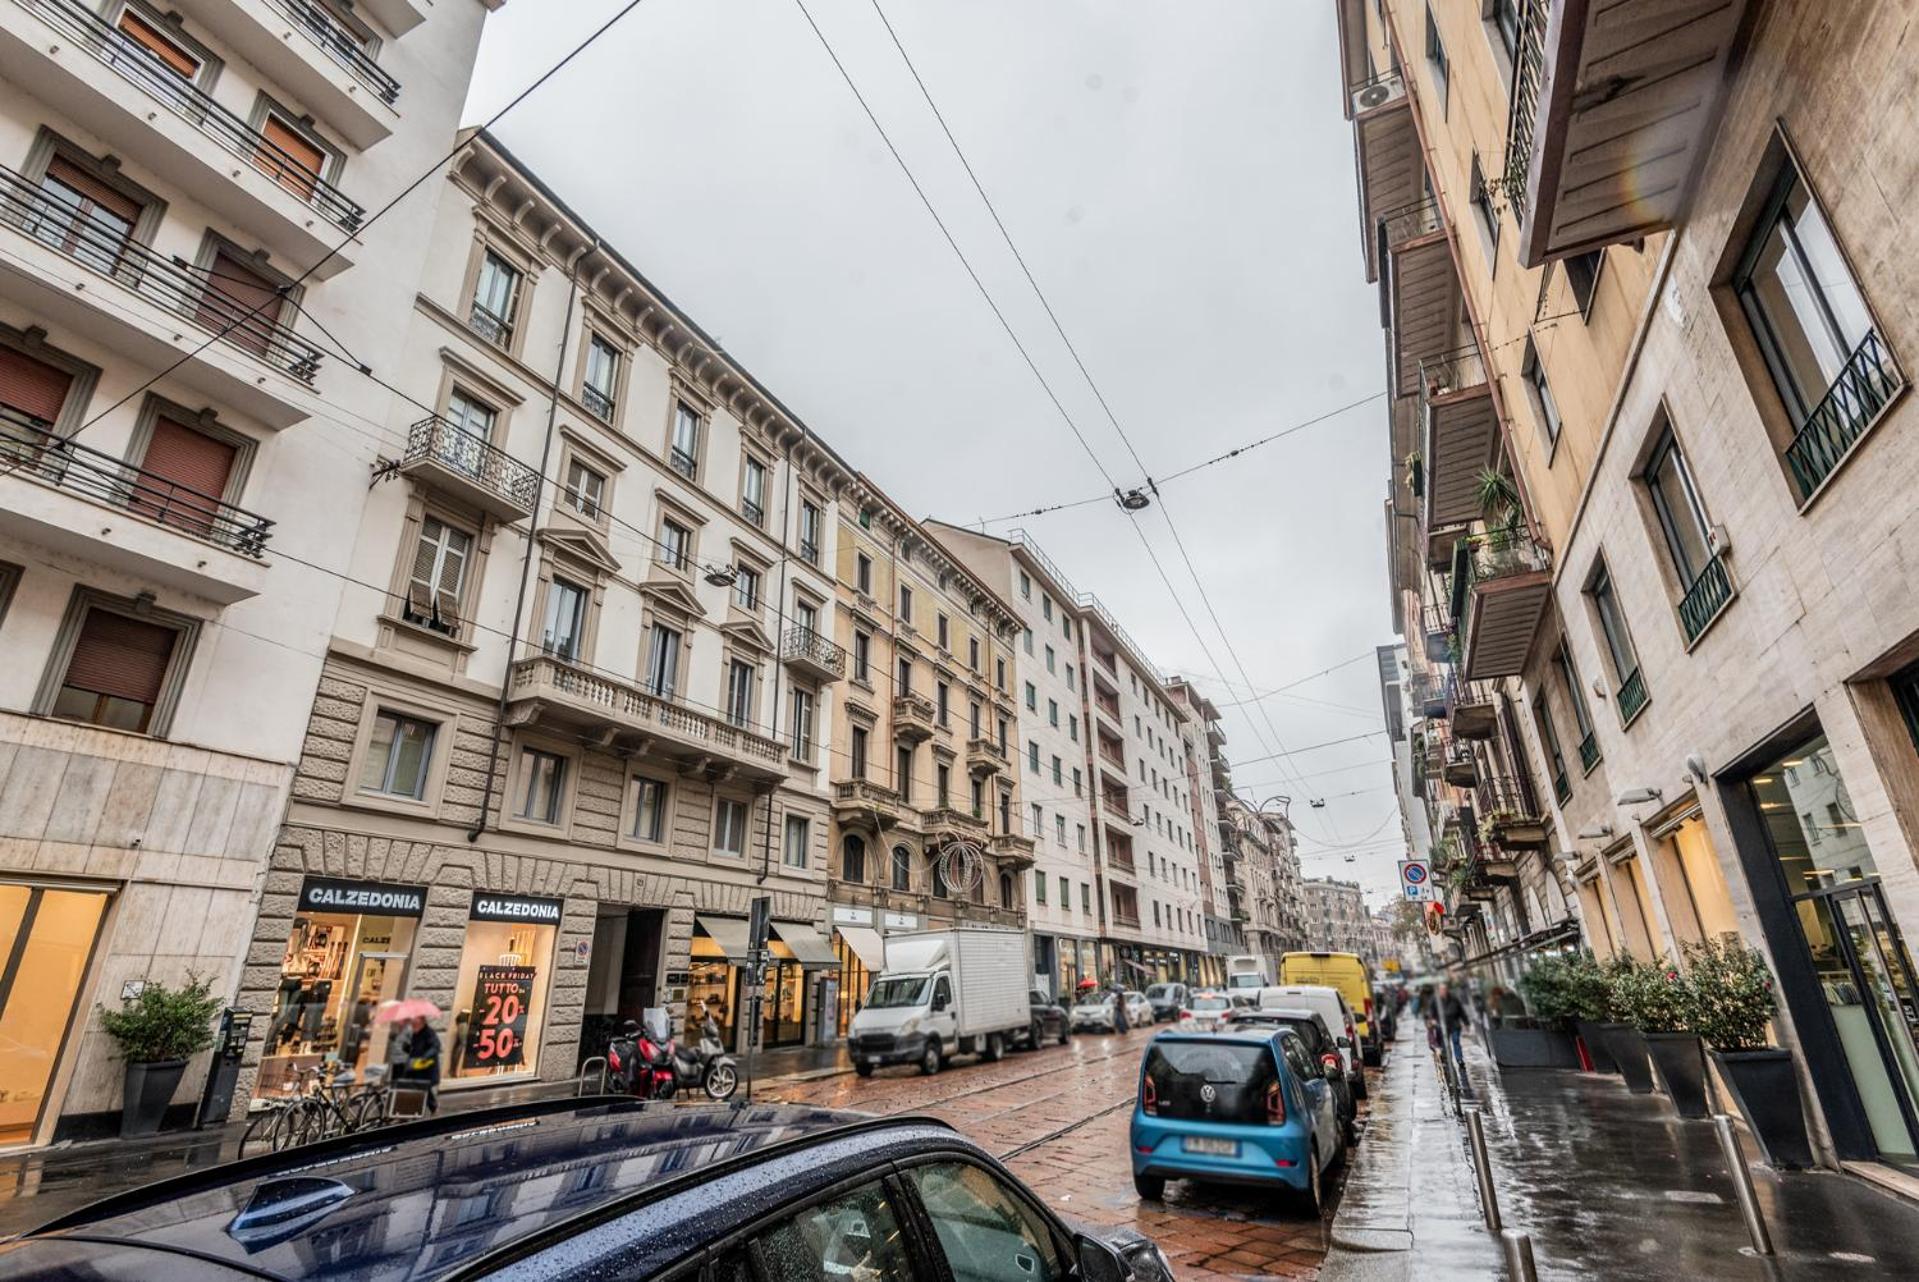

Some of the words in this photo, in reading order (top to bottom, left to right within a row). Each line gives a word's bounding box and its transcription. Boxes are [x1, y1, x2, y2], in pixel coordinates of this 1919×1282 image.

[309, 888, 420, 909] CALZEDONIA
[477, 900, 559, 918] CALZEDONIA
[508, 972, 534, 980] FRIDAY
[484, 983, 519, 993] TUTTO
